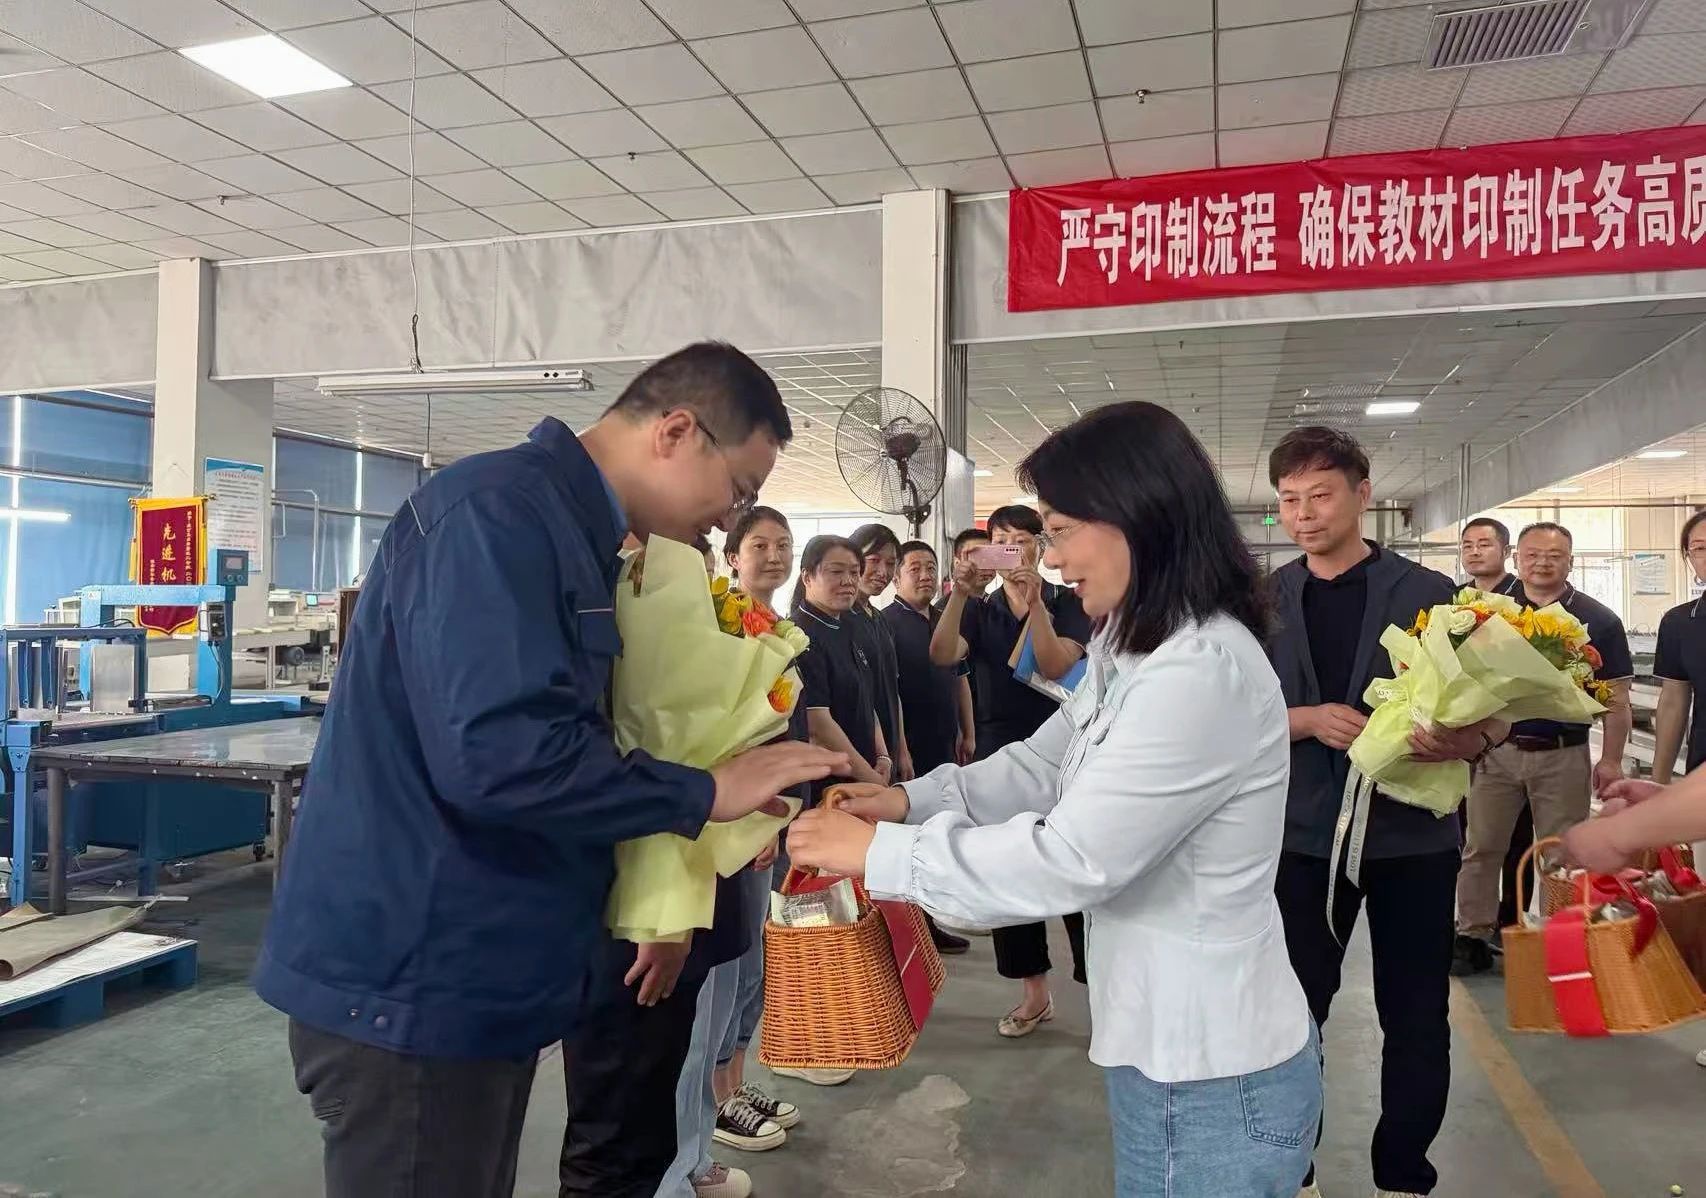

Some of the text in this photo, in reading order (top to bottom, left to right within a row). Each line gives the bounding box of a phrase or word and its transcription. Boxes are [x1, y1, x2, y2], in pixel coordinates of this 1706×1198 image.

[1057, 191, 1277, 287] 严守印制流程
